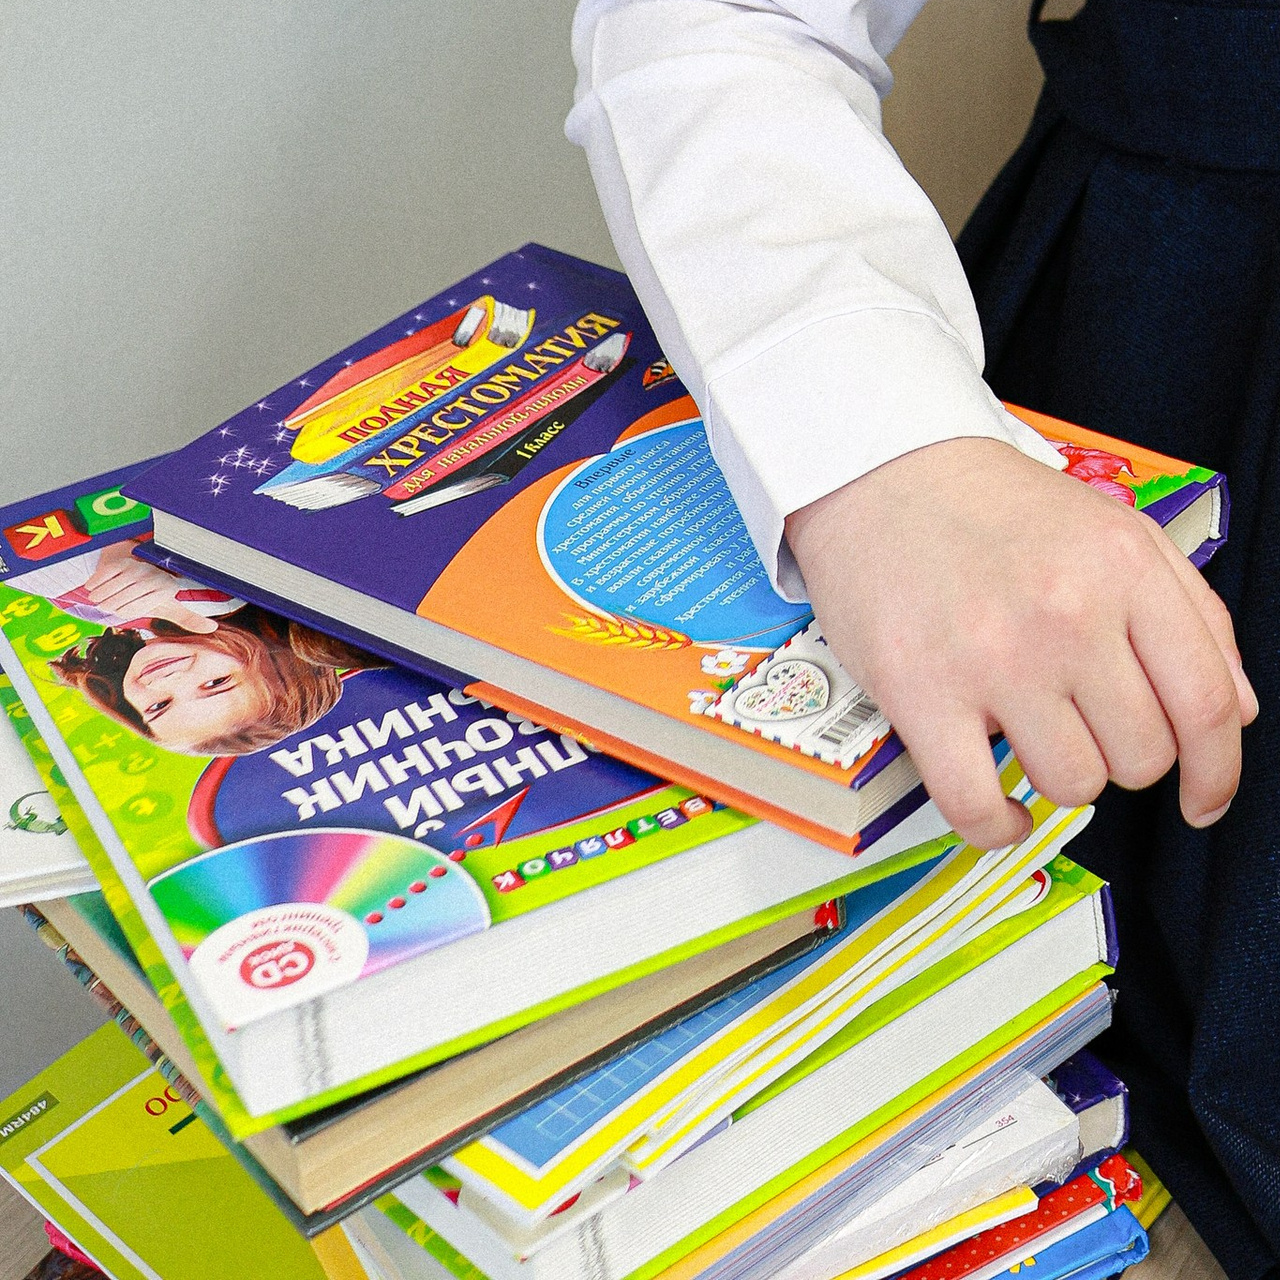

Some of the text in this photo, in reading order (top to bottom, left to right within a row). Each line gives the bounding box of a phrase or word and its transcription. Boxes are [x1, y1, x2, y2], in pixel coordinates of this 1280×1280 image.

[338, 365, 472, 444] ПОЛНАЯ
[364, 312, 622, 478] ХРЕСТОМАТИЯ
[515, 419, 565, 461] 1 класс
[572, 494, 592, 510] для
[591, 465, 635, 496] первого
[634, 439, 670, 465] класса
[574, 448, 636, 489] Впервые
[622, 449, 699, 503] объединяющая
[566, 496, 612, 528] средней
[611, 469, 648, 497] школы
[649, 431, 705, 471] составлена
[576, 463, 720, 566] Министерством образовани
[570, 512, 632, 556] программы
[630, 501, 647, 514] по
[571, 578, 584, 587] В
[584, 528, 650, 579] хрестоматии
[652, 492, 700, 529] наиболее
[585, 490, 724, 593] и возрастные потребности
[606, 565, 645, 594] вошли
[683, 497, 735, 538] произведе
[636, 534, 706, 587] современной
[706, 508, 741, 536] детско
[625, 603, 636, 613] и
[634, 555, 700, 606] зарубежной
[654, 547, 732, 607] сформировать
[674, 570, 745, 624] Хрестоматия
[719, 577, 759, 607] чтения
[493, 796, 707, 891] ВЕТЛЯЧОК
